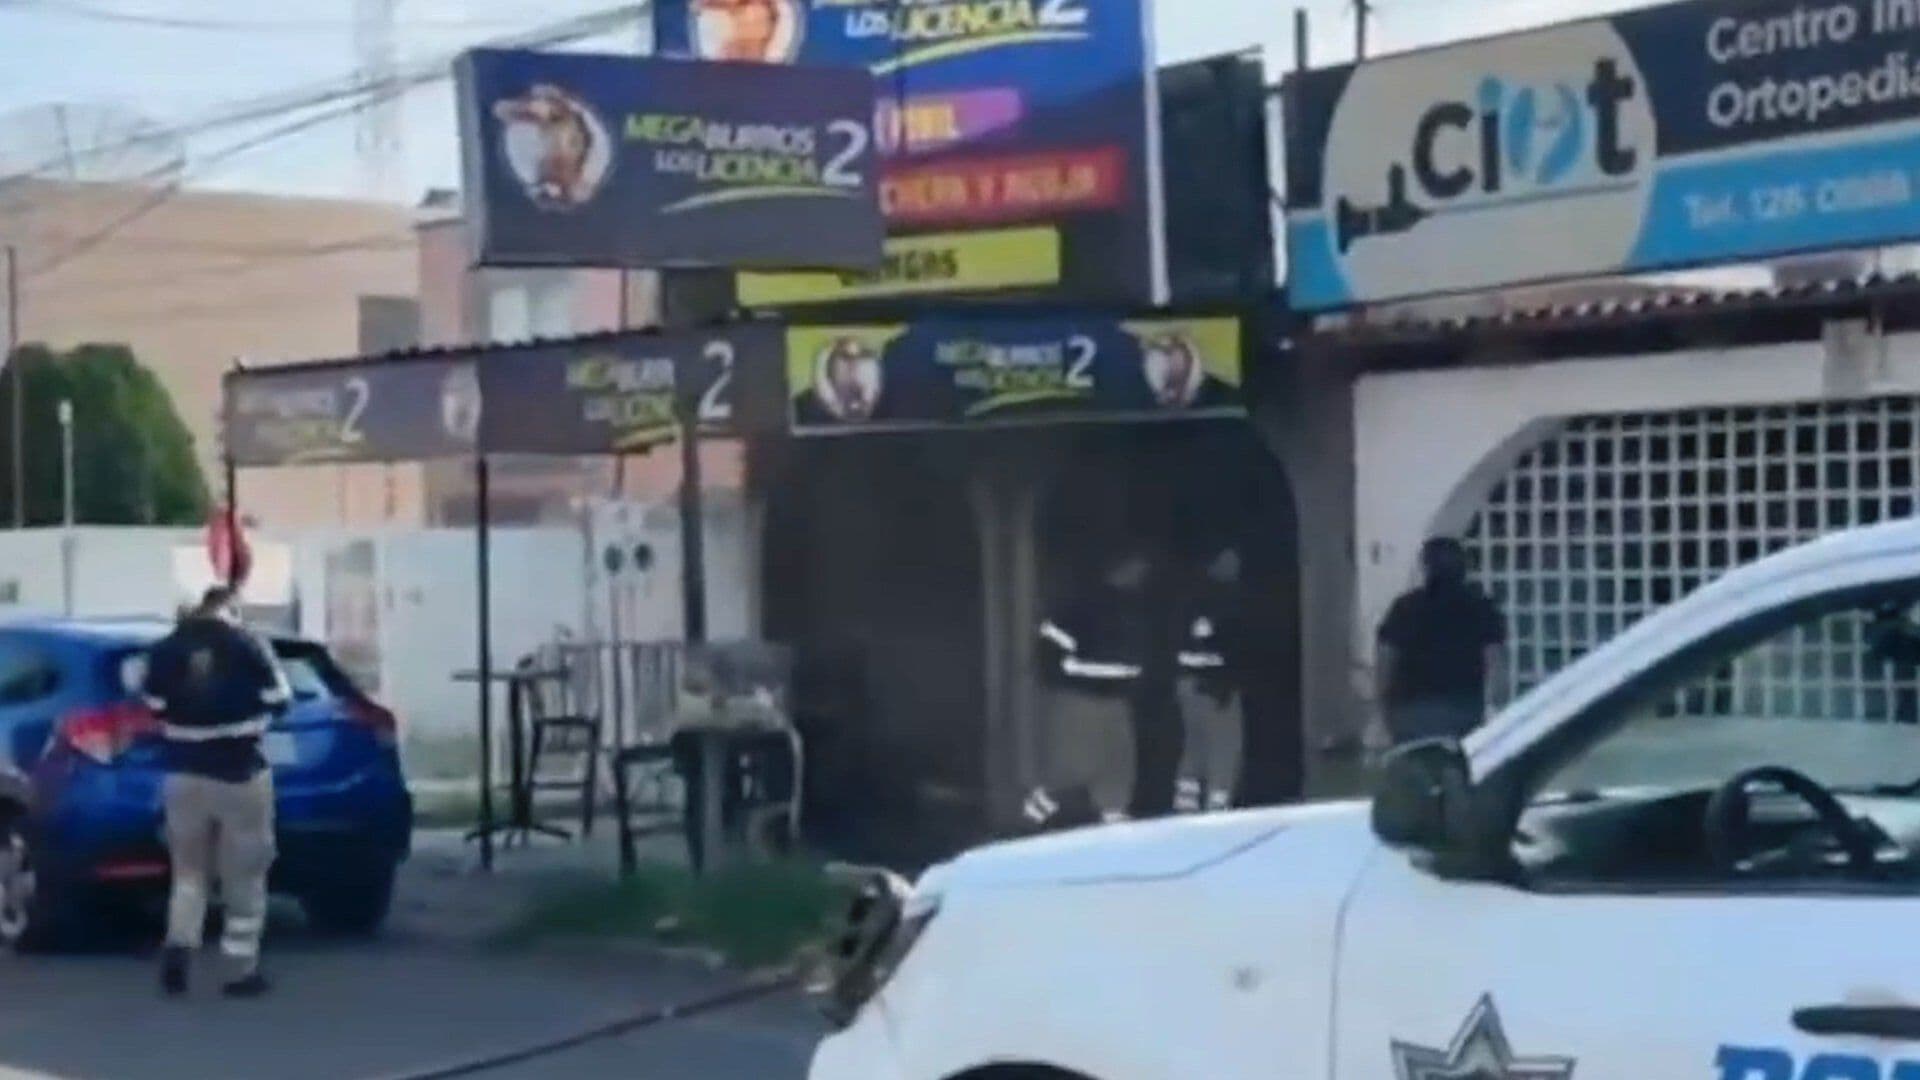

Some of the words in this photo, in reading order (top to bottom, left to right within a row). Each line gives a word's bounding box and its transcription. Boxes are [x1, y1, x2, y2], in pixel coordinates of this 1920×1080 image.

[1706, 4, 1858, 64] Centro
[1872, 0, 1920, 33] In
[822, 119, 868, 187] 2
[698, 339, 734, 420] 2
[1066, 334, 1097, 387] 2
[340, 376, 370, 443] 2
